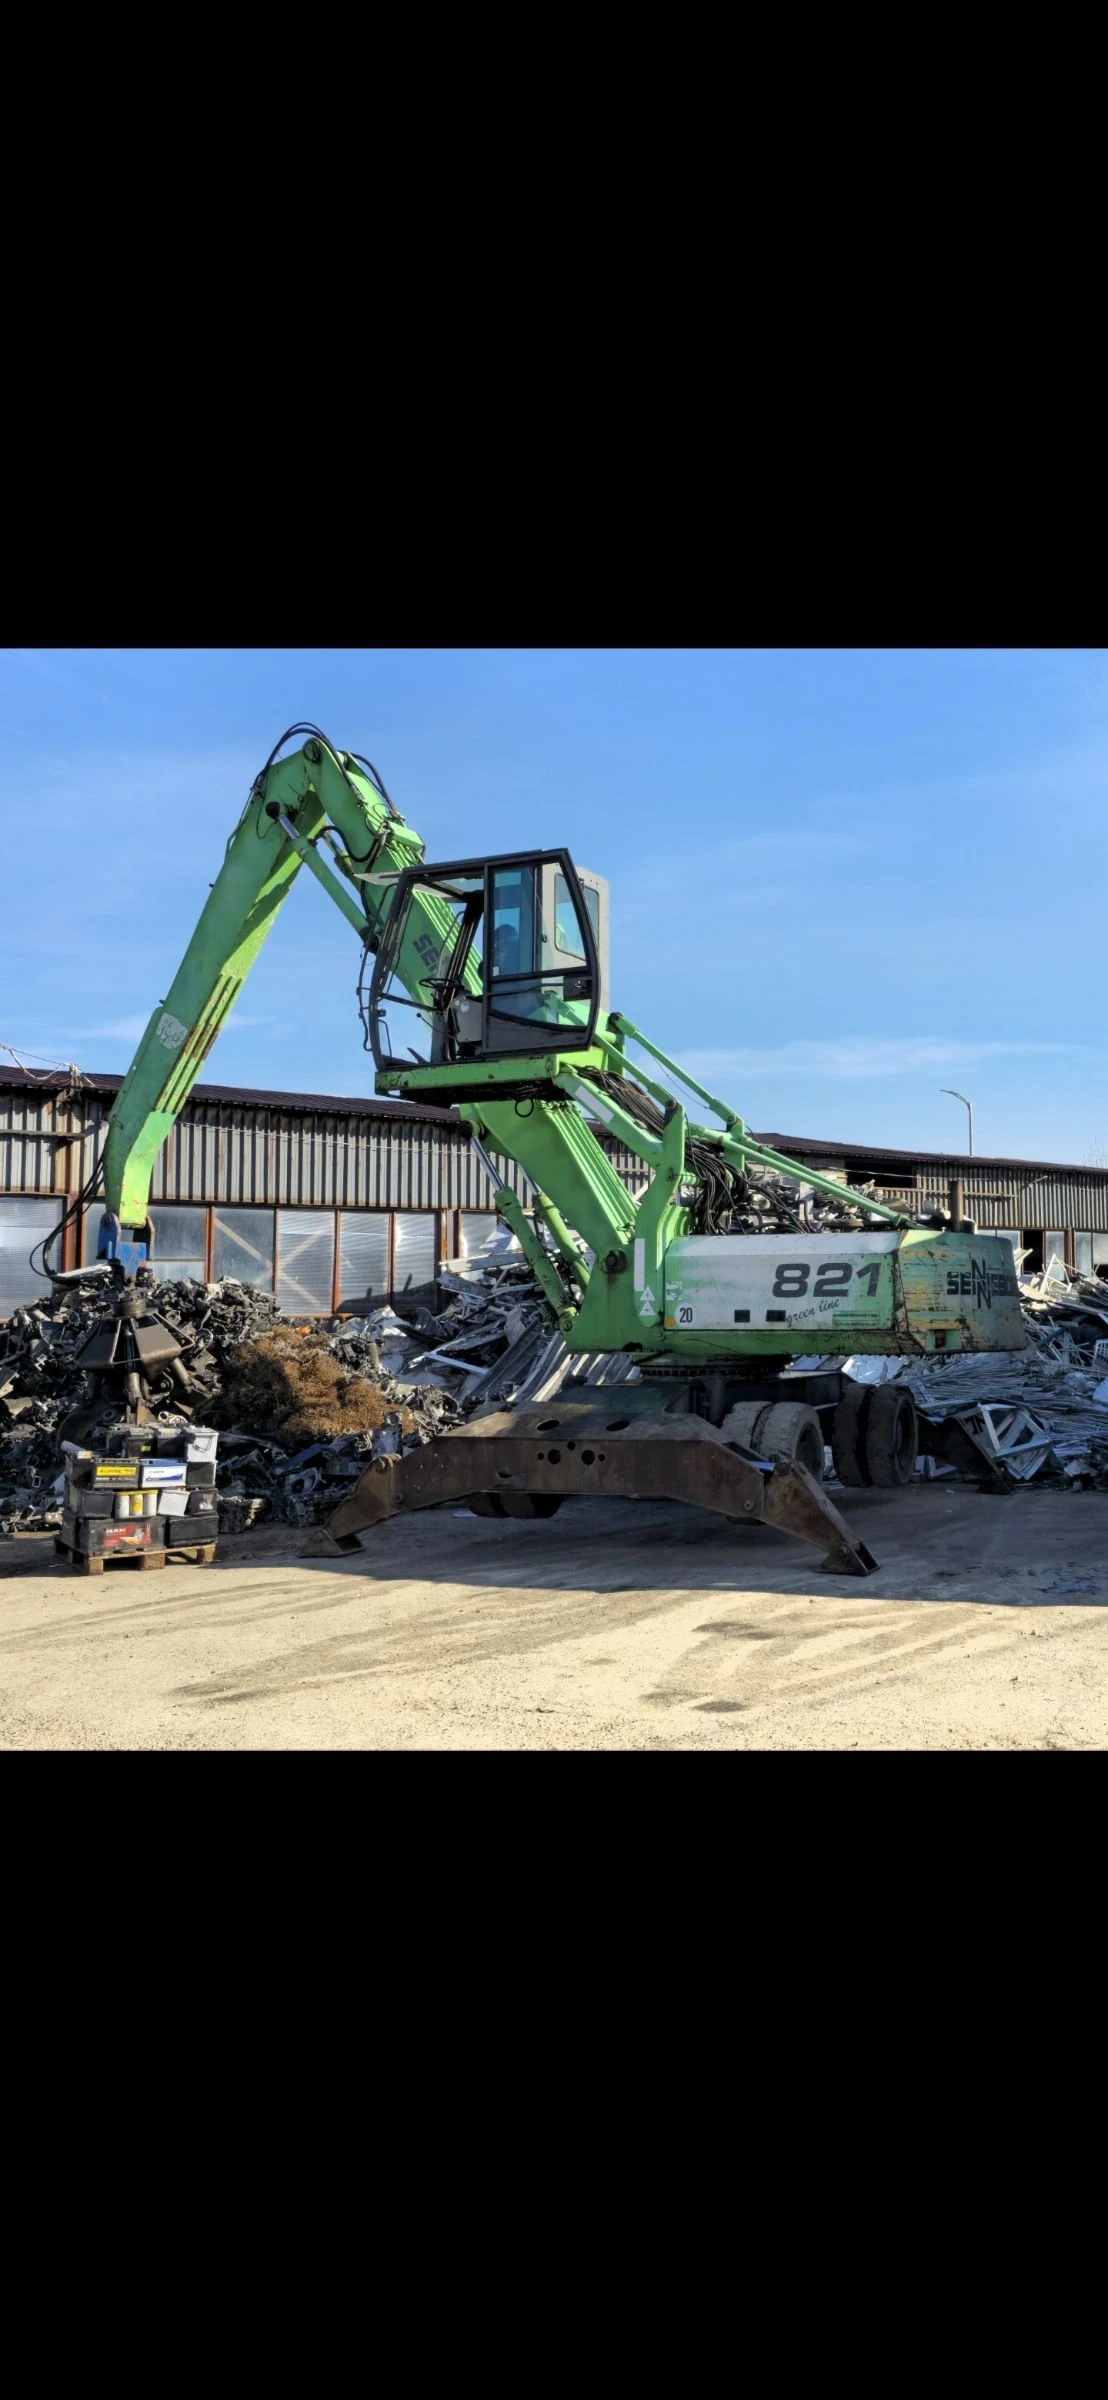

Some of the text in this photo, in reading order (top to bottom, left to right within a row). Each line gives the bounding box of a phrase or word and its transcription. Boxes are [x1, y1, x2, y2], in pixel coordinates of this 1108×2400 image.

[772, 1263, 882, 1298] 821
[679, 1307, 693, 1323] 20
[786, 1298, 840, 1328] green line
